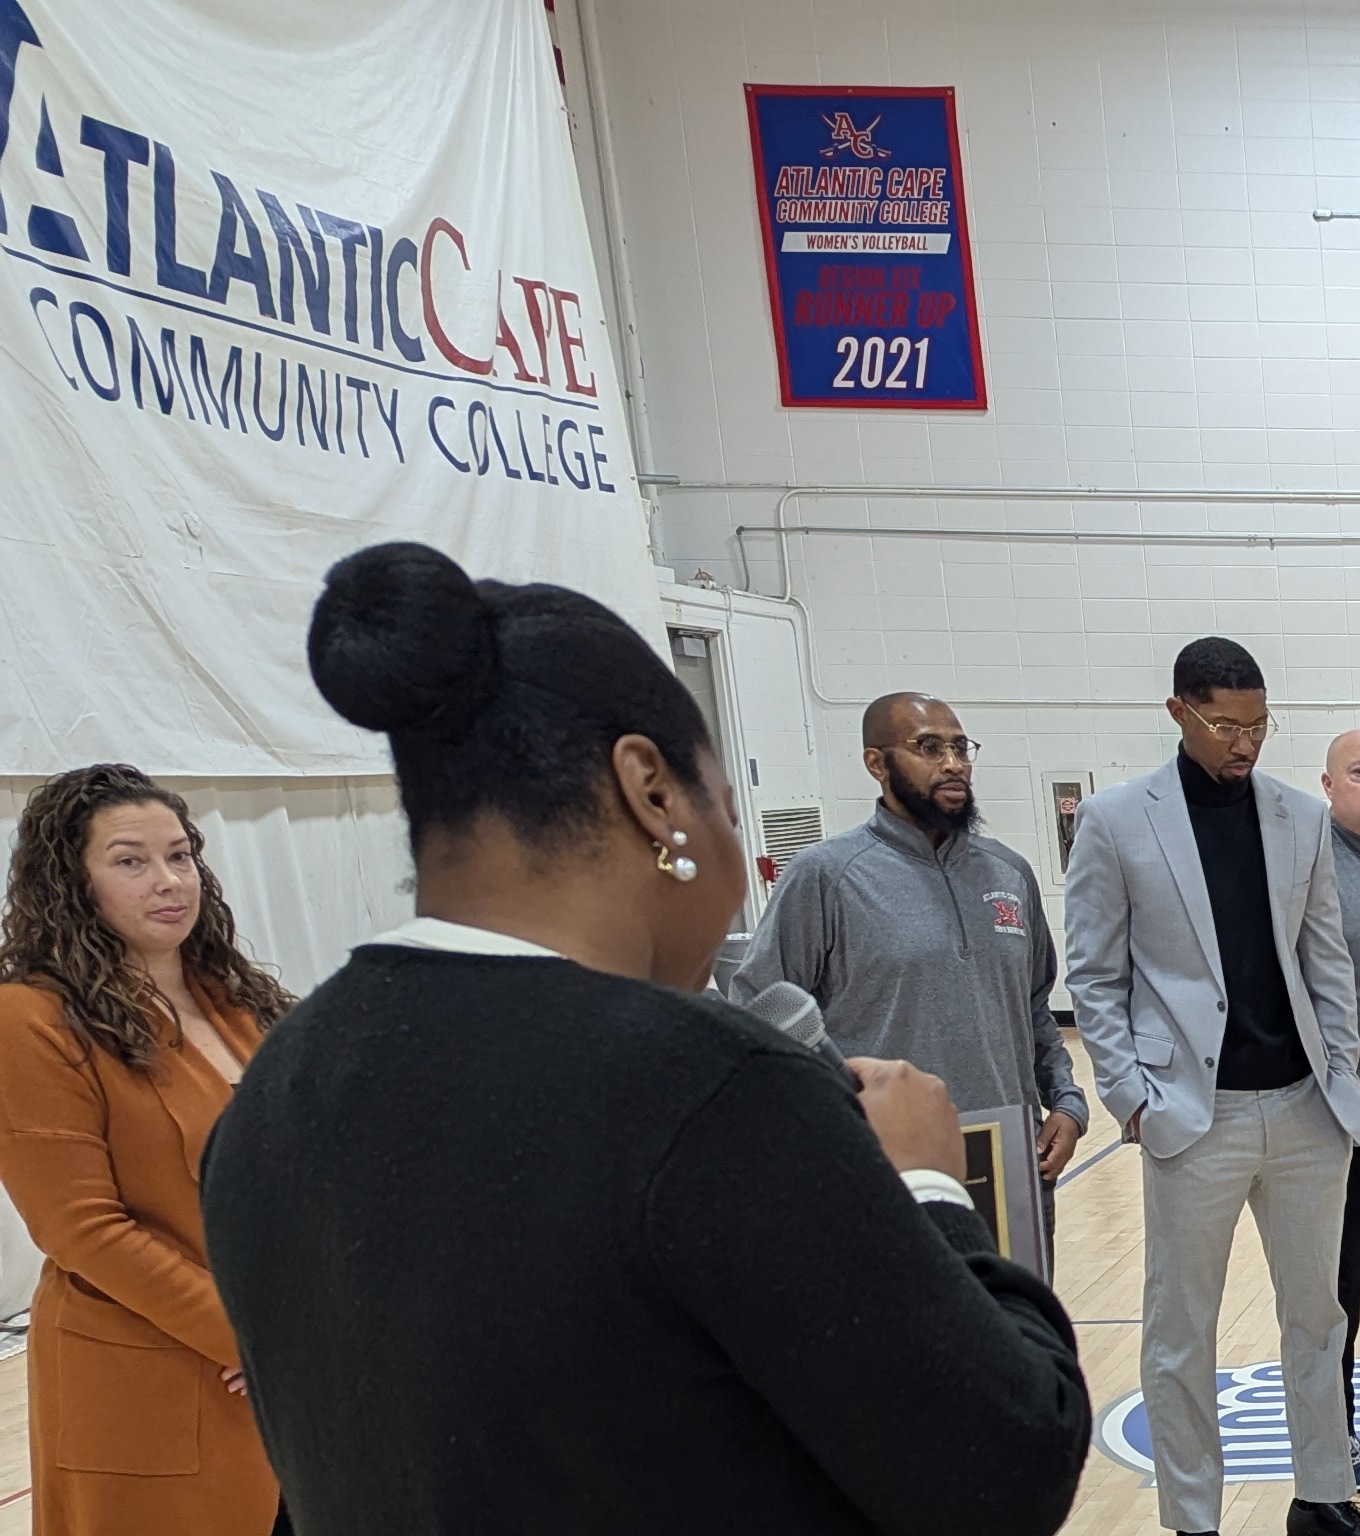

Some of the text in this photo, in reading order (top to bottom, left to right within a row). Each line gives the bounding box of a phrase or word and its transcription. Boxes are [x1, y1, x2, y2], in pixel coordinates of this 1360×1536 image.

[775, 166, 946, 198] ATLANTIC CAPE
[776, 199, 950, 225] COMMUNITY COLLEGE
[806, 234, 929, 251] WOMEN'S VOLLEYBALL
[794, 290, 956, 328] RUNNER UP
[832, 336, 929, 389] 2021
[29, 287, 615, 493] COMMUNITY COLLEGE
